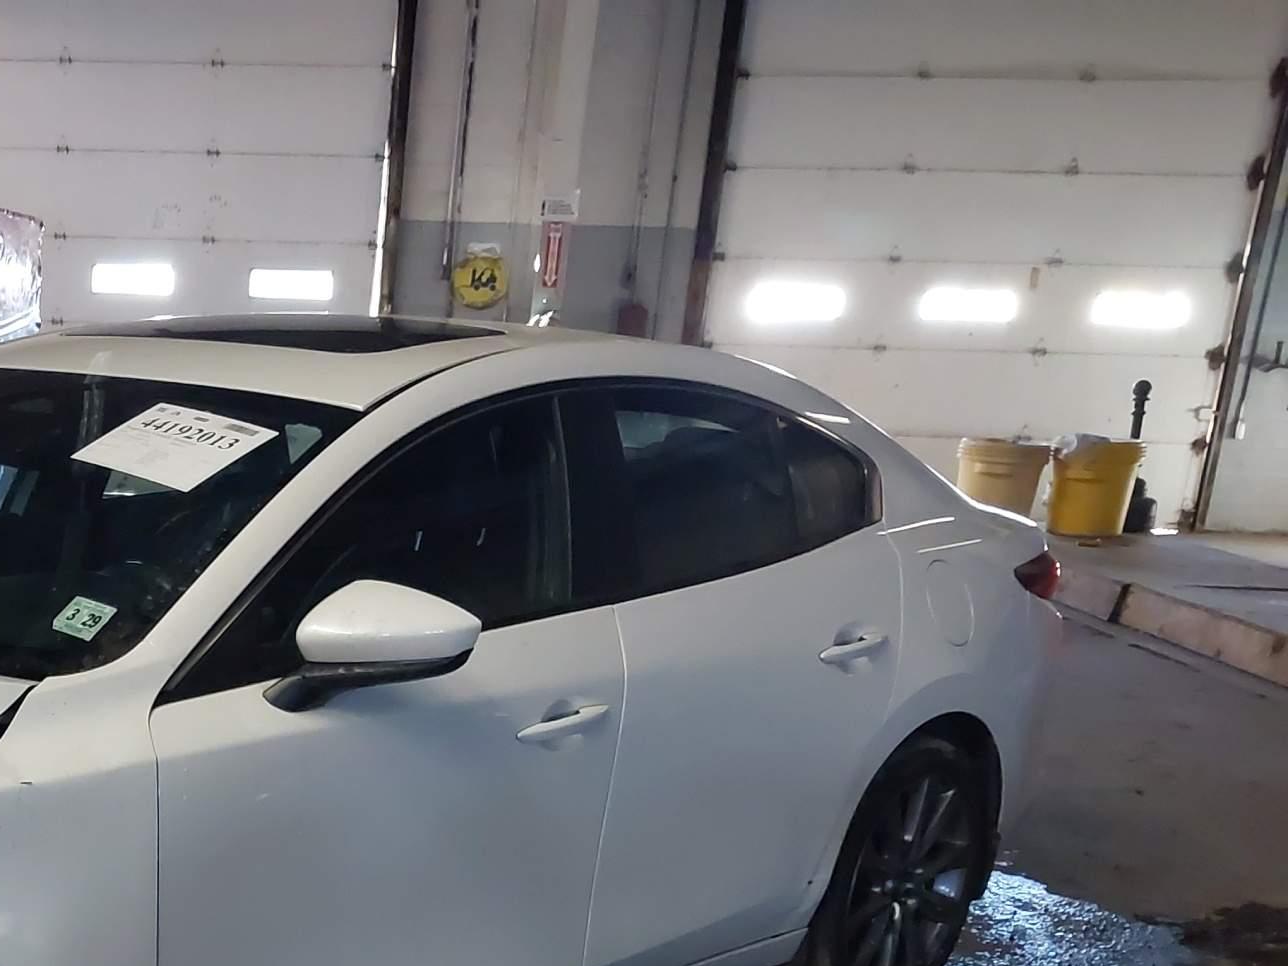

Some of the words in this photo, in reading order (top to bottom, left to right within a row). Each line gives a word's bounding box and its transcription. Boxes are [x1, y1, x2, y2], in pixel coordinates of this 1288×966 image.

[141, 417, 241, 450] 44192013
[66, 608, 81, 621] 3
[80, 613, 102, 628] 29
